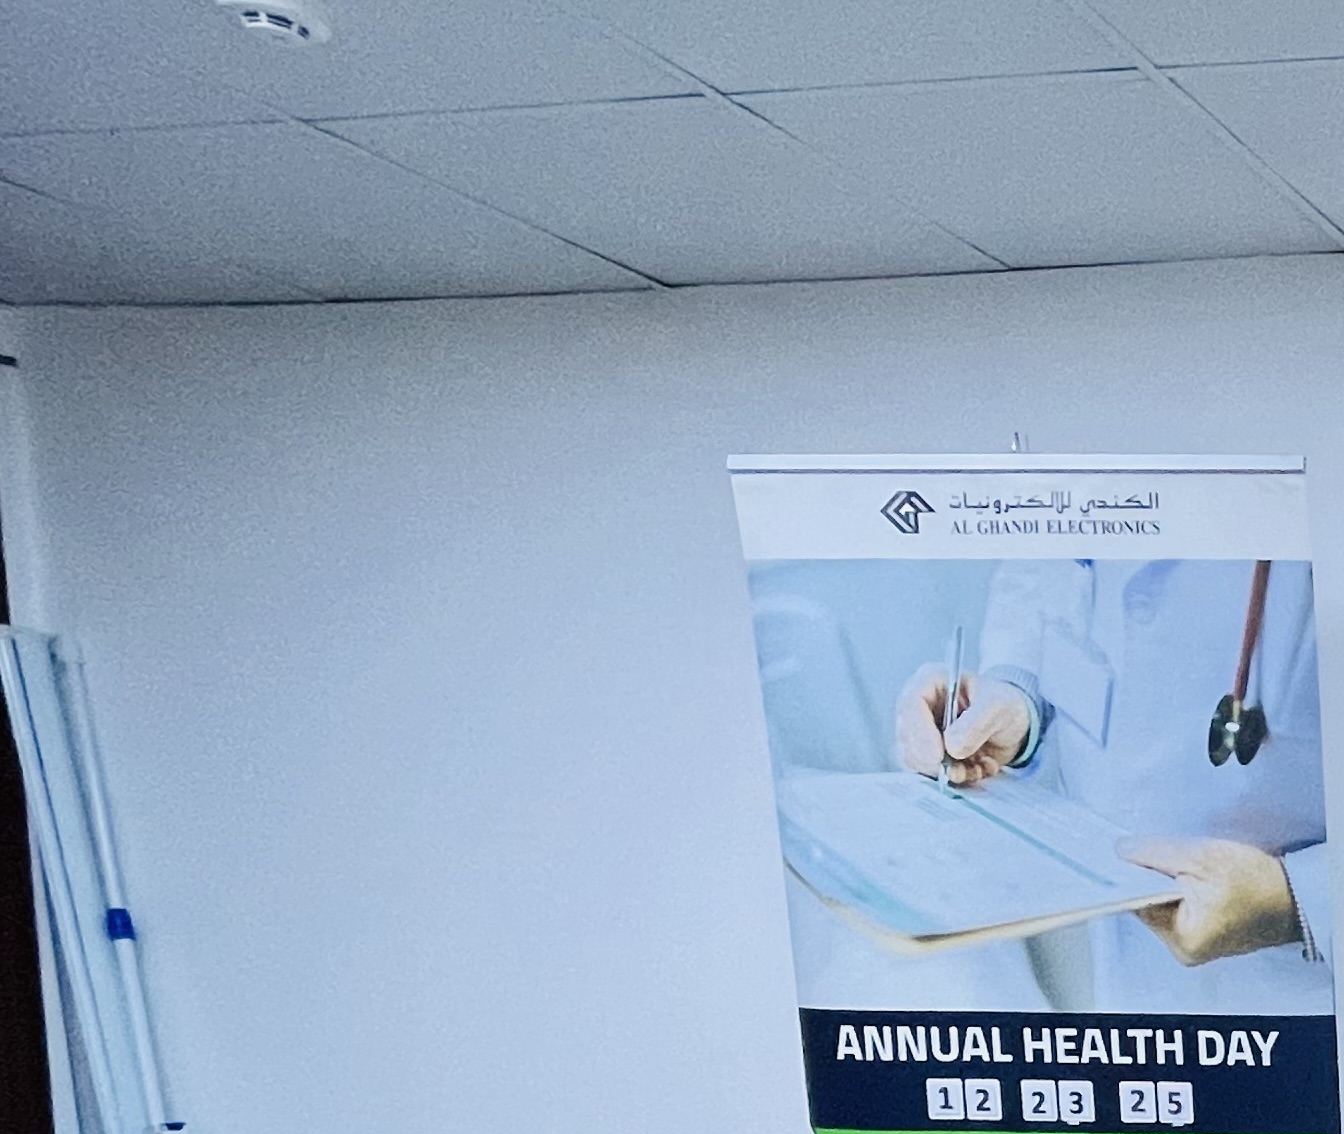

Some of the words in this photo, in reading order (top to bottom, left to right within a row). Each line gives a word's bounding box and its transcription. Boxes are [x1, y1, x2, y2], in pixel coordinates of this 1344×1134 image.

[951, 519, 973, 535] AL
[977, 519, 1040, 535] GHANDI
[1047, 519, 1161, 536] ELECTRONICS
[836, 1024, 1014, 1063] ANNUAL
[1024, 1027, 1184, 1065] HEALTH
[1198, 1030, 1280, 1067] DAY
